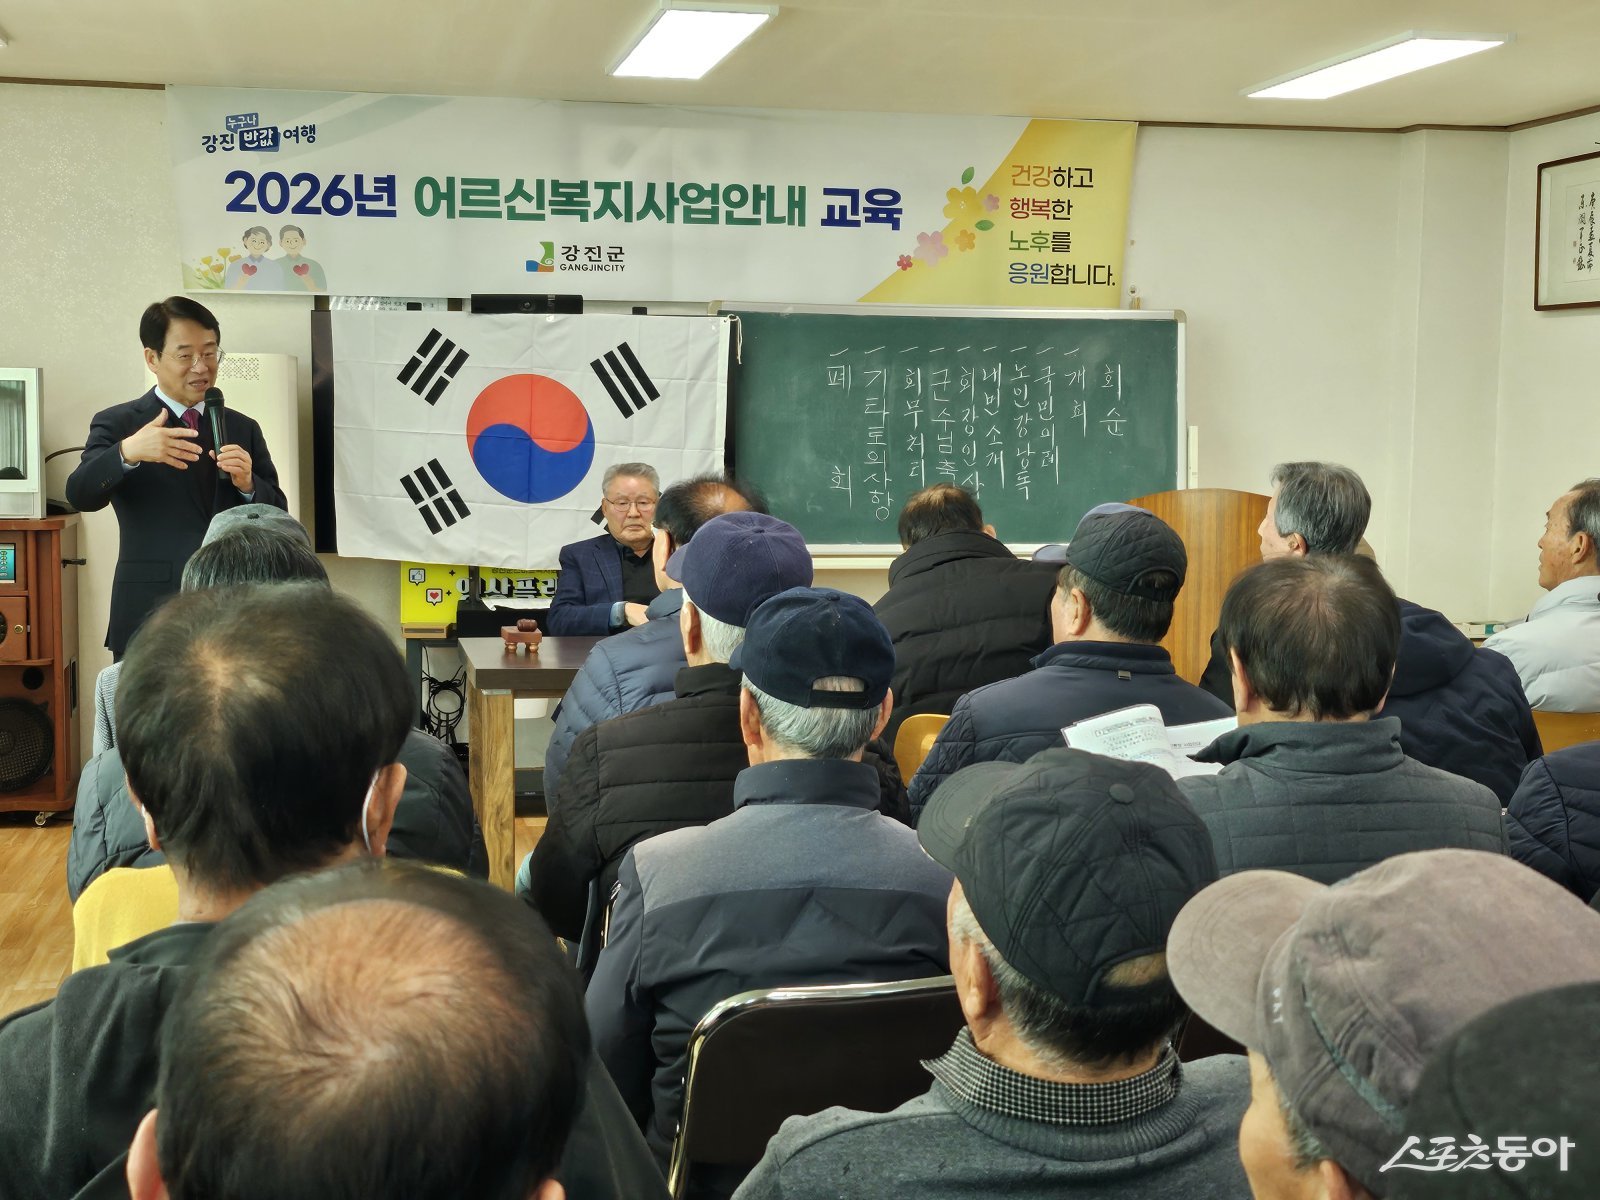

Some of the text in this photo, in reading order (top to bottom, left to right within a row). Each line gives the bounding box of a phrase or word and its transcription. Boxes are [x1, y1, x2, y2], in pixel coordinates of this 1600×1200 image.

[227, 114, 257, 129] 누구나
[201, 124, 316, 154] 강진 반값 여행
[1010, 164, 1094, 190] 건강하고
[223, 170, 903, 231] 2026년 어르신복지사업안내 교육
[1009, 198, 1074, 221] 행복한
[1008, 230, 1072, 253] 노후를
[560, 244, 626, 263] 강진군
[559, 263, 626, 272] GANGJINCITY
[1008, 262, 1117, 287] 응원합니다.
